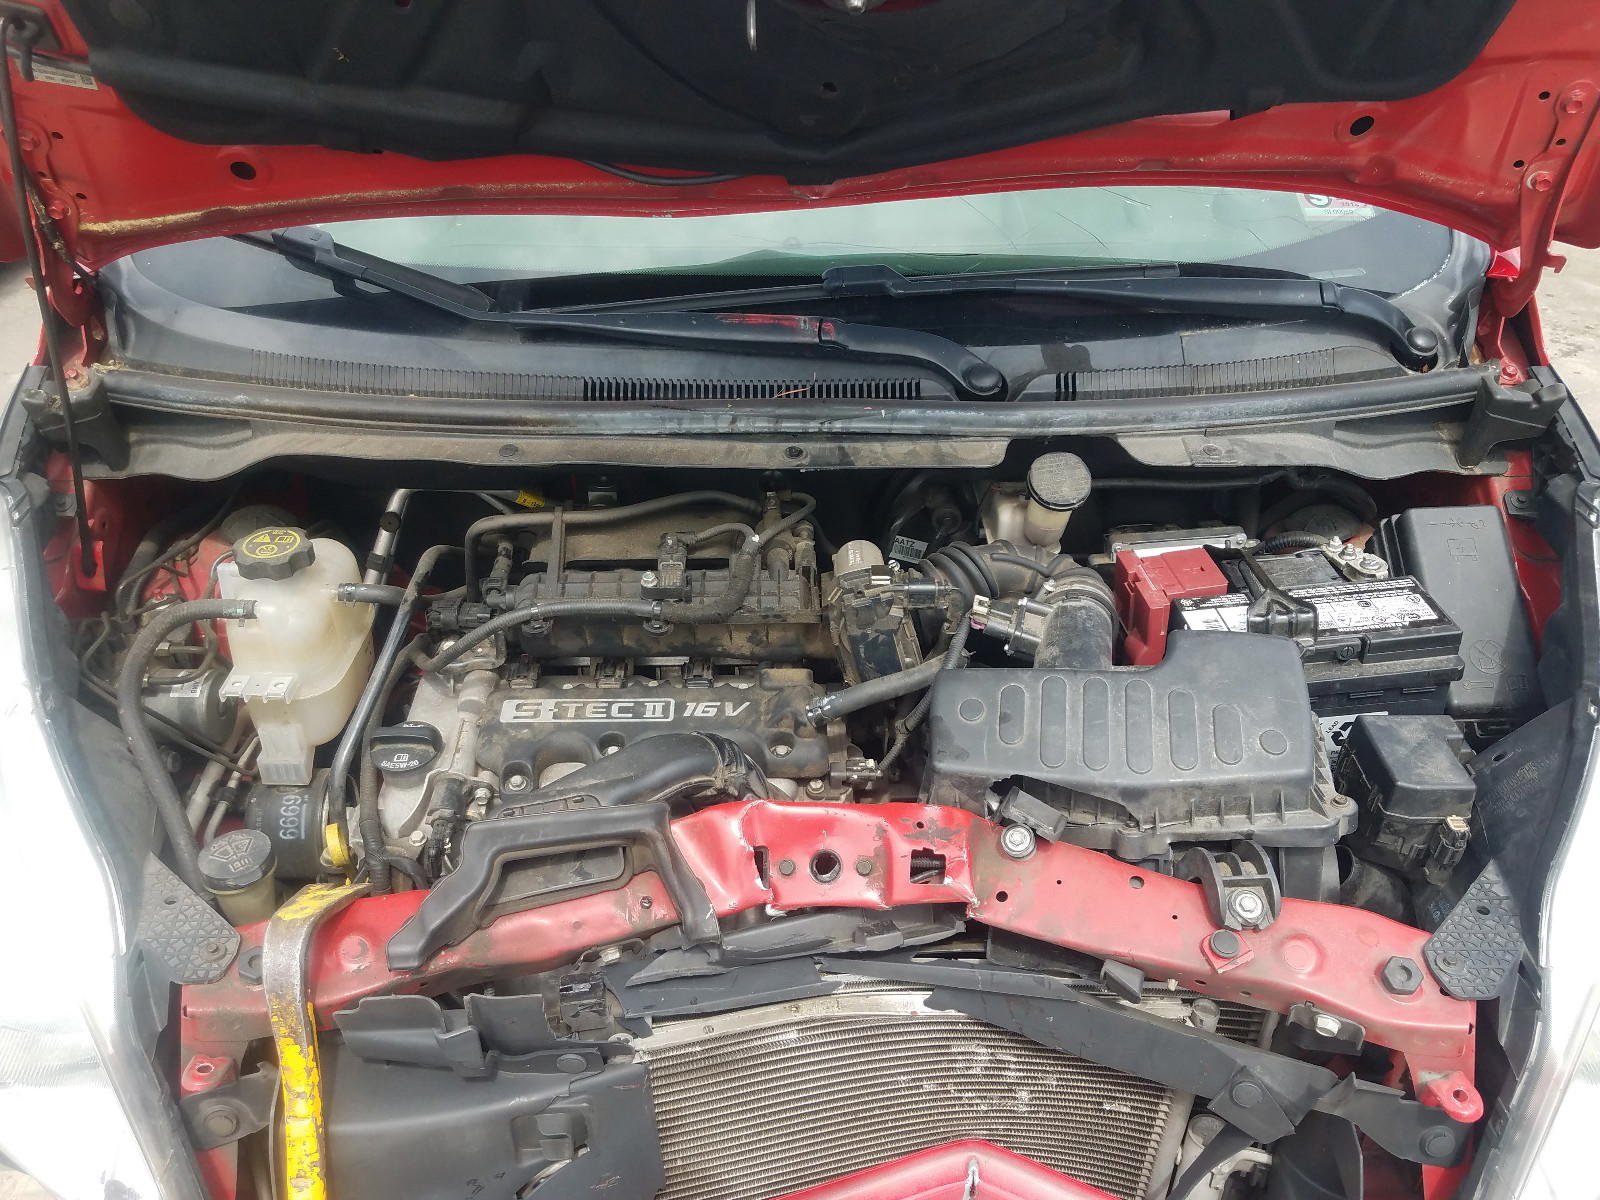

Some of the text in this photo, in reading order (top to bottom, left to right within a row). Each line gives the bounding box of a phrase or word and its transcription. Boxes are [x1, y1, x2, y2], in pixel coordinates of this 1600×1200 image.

[895, 537, 916, 548] AATZ
[1325, 720, 1339, 734] LEAD
[279, 794, 302, 840] 6669
